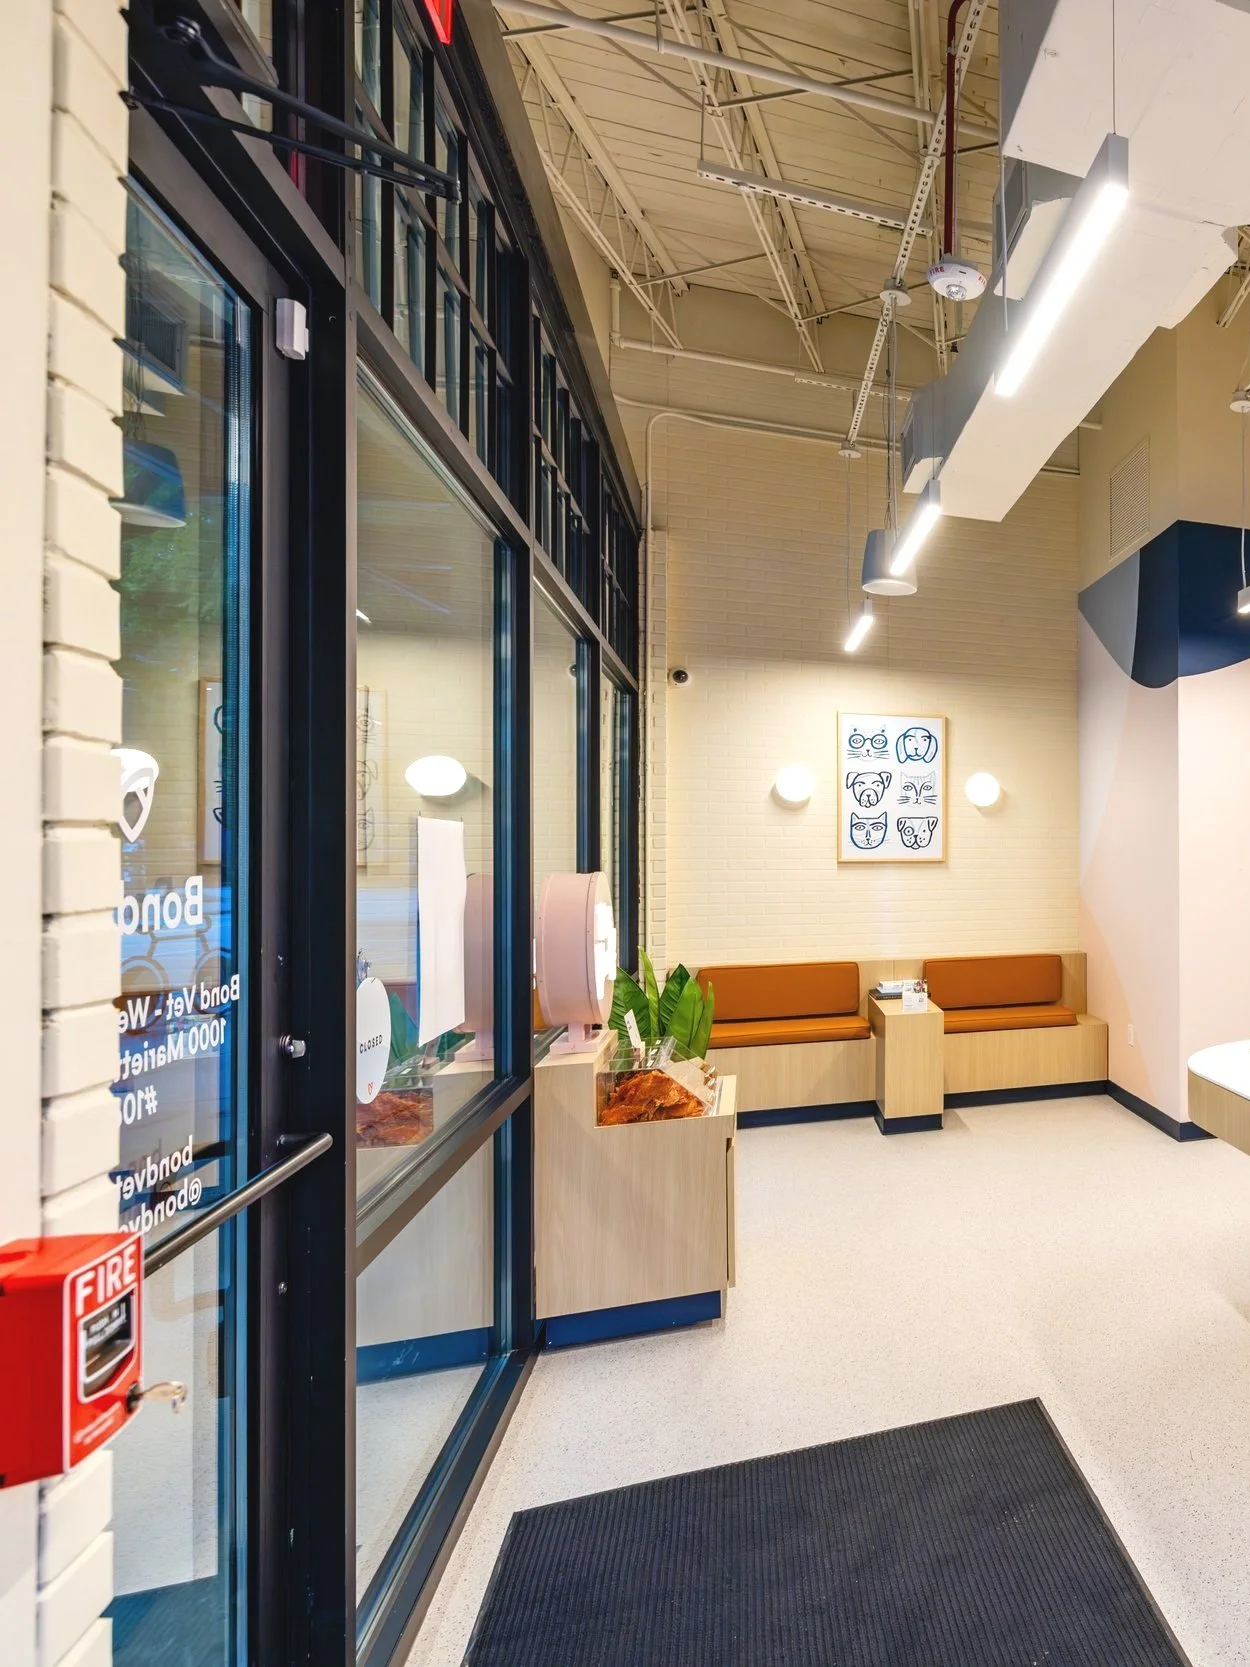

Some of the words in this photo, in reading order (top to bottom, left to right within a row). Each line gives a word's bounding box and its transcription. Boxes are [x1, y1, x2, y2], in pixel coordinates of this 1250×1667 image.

[930, 266, 945, 276] FIRE
[359, 1034, 383, 1054] CLOSED
[75, 1244, 136, 1317] FIRE
